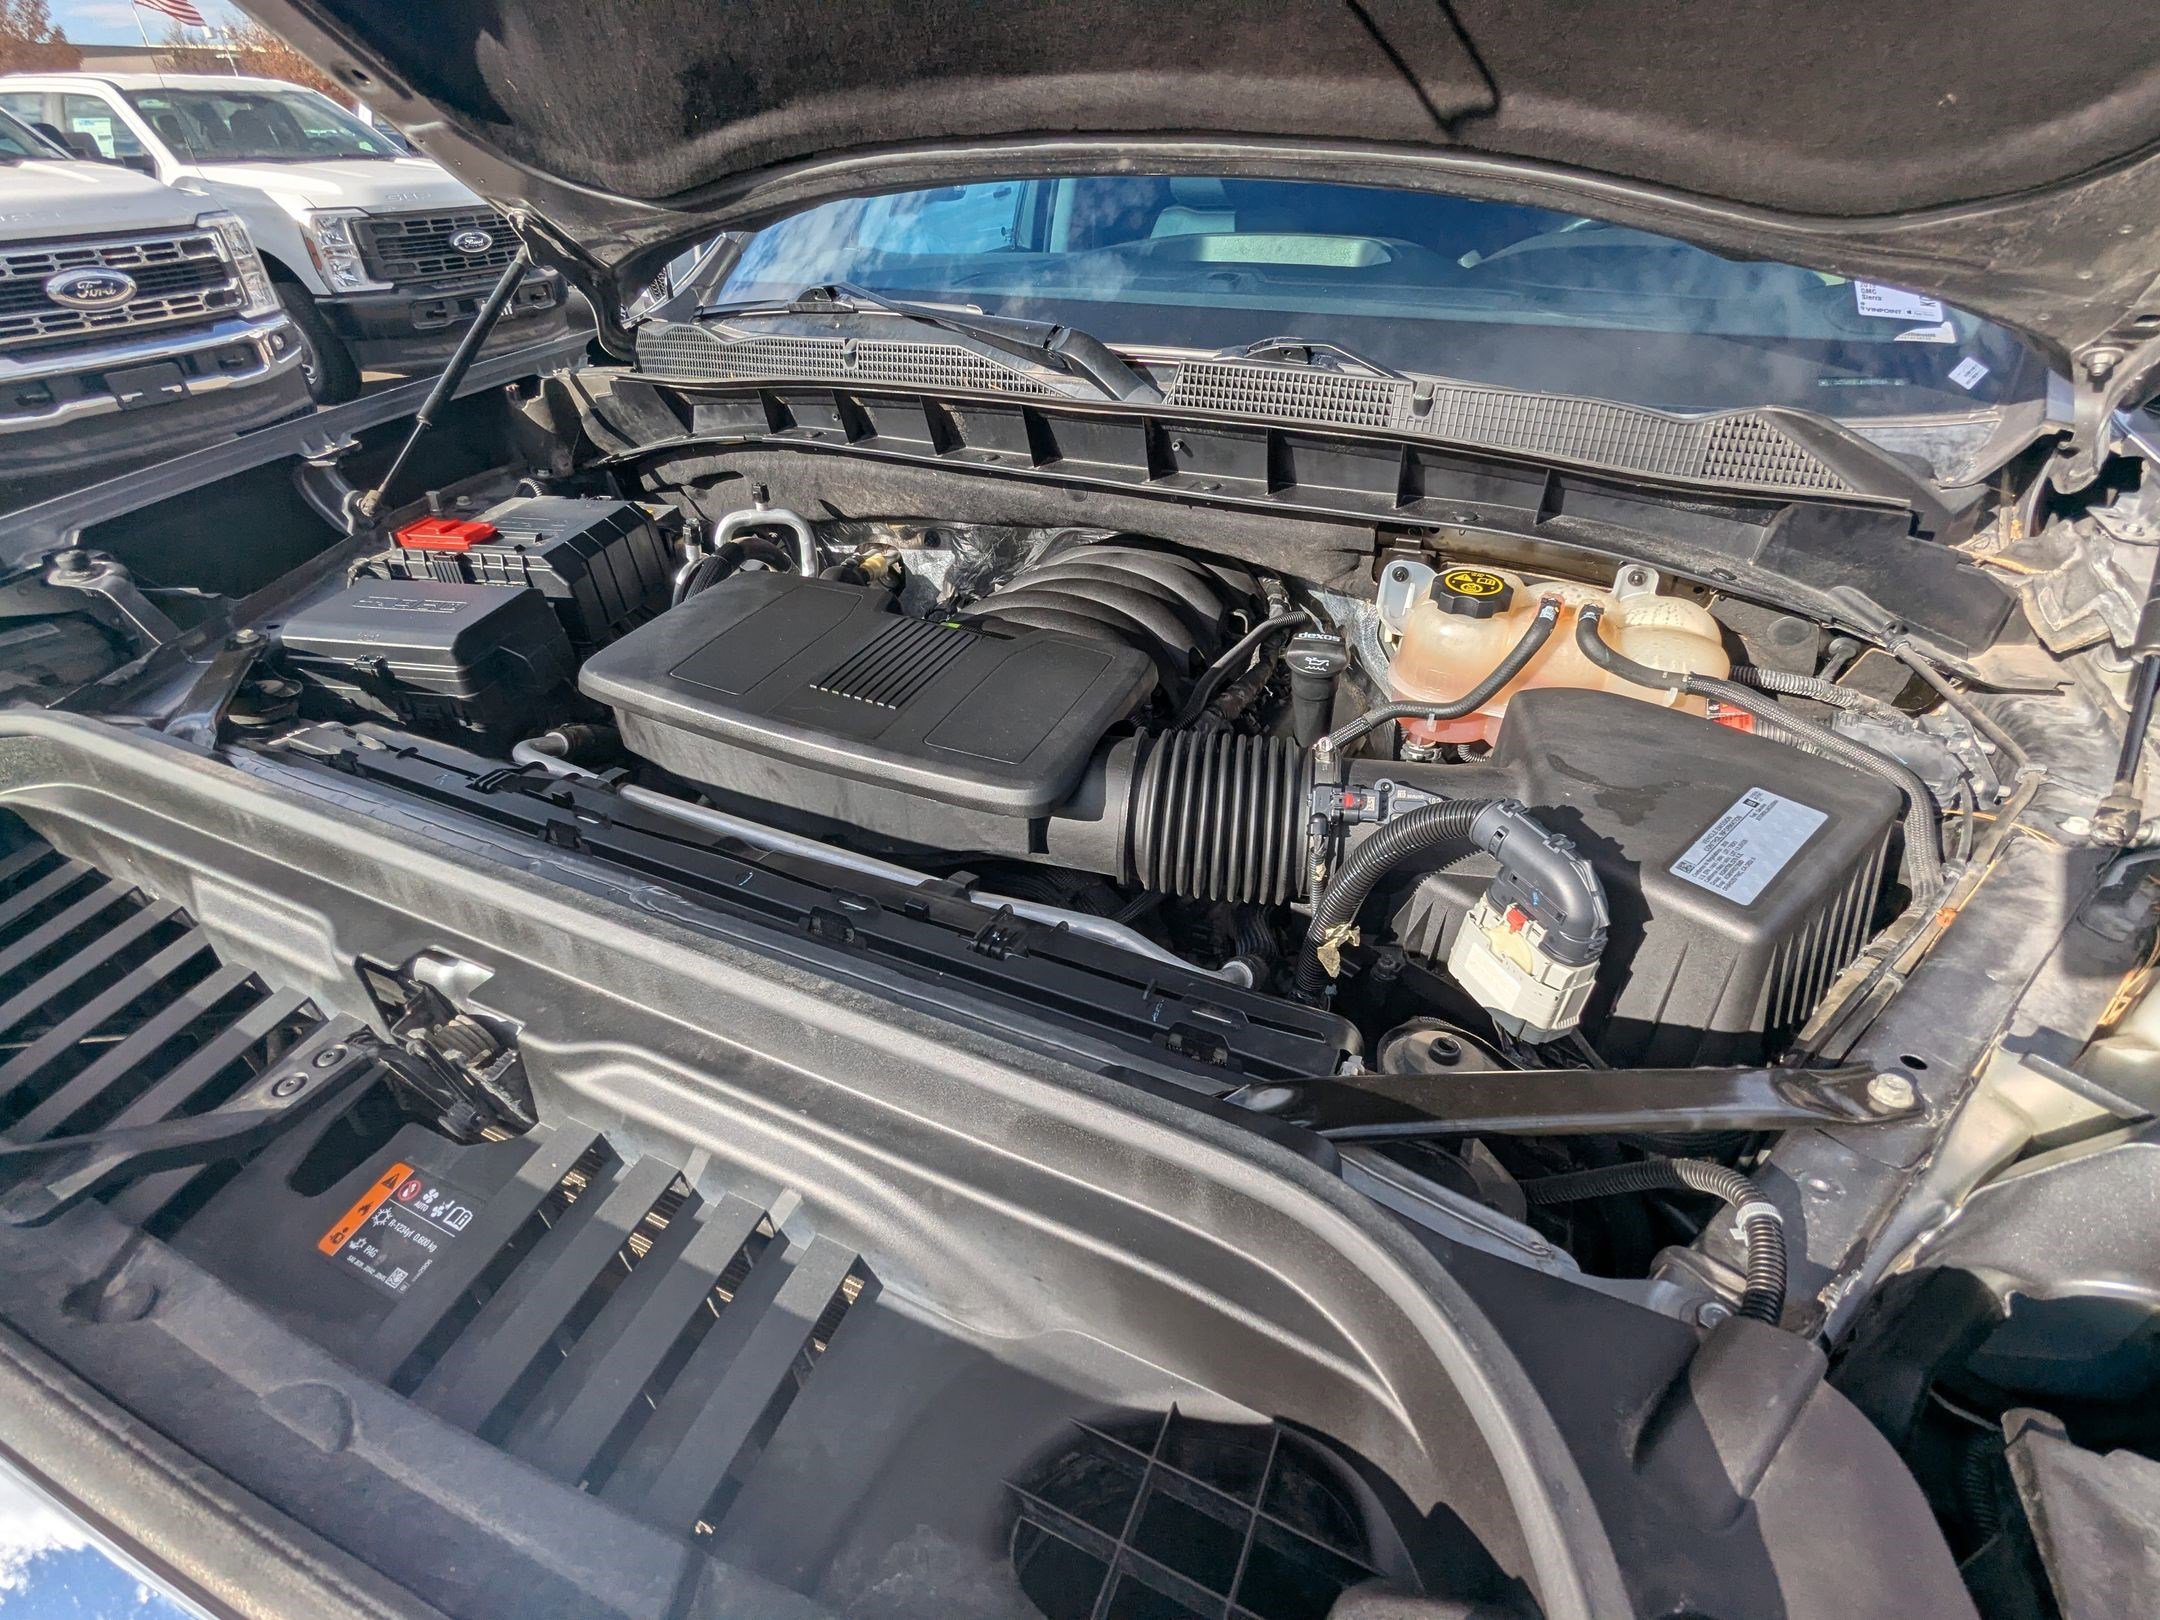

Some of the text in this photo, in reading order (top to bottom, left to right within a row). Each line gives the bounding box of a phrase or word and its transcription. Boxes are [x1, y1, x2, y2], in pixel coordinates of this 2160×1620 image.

[76, 280, 117, 299] Ford
[1298, 631, 1341, 642] dexos
[413, 1200, 429, 1211] AUTO
[387, 1219, 439, 1253] R-1234yf 0.600 kg
[362, 1244, 379, 1258] PAG
